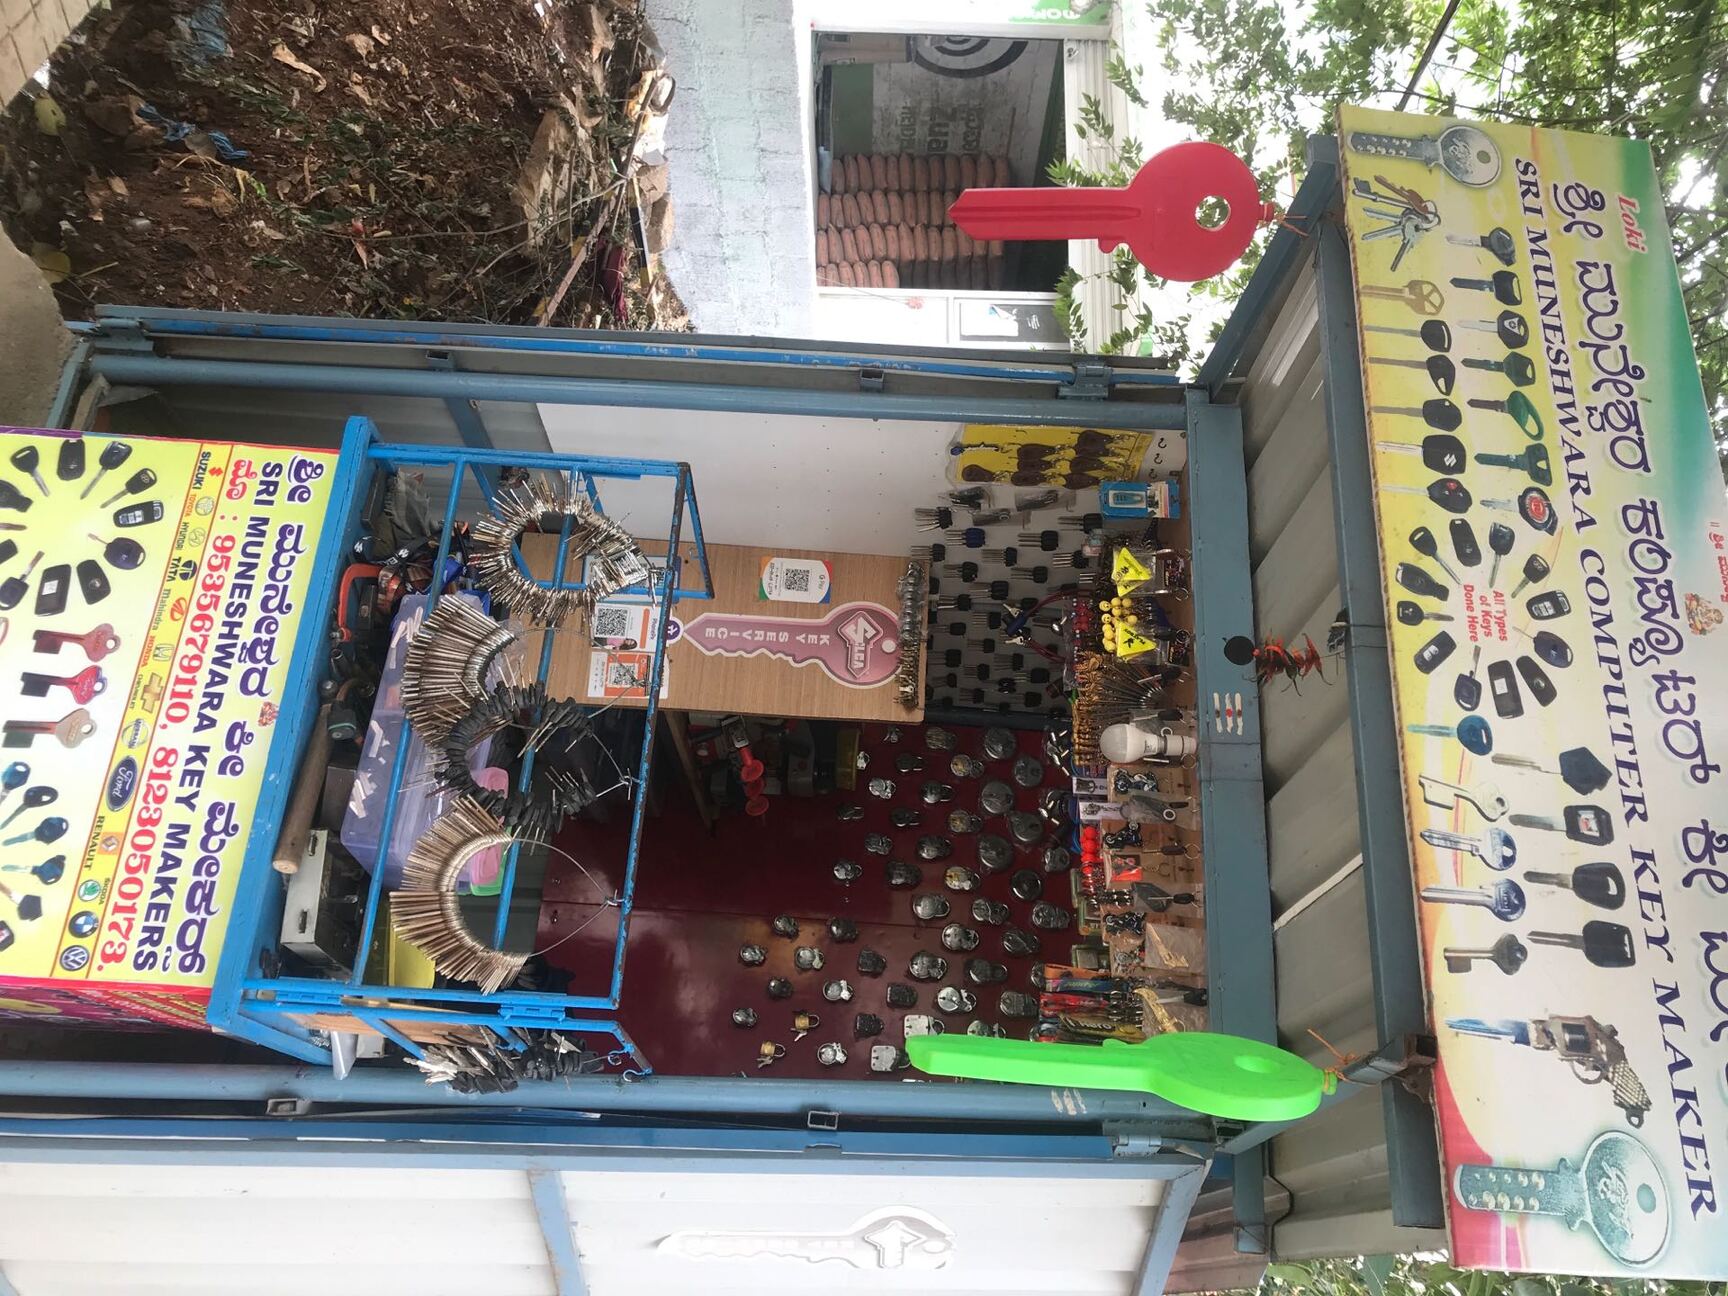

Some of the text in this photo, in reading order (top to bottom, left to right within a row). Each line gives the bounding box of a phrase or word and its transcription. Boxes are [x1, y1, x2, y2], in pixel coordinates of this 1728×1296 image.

[1515, 158, 1544, 219] SRI
[1553, 182, 1606, 239] ಶ್ರೀ
[1617, 196, 1646, 252] Loki
[1526, 226, 1597, 535] MUNESHWARA
[1576, 261, 1651, 473] ಮುನೇಶ್ವರ
[192, 451, 212, 490] SUZUKI
[254, 462, 283, 506] SRI
[288, 457, 324, 503] ಶ್ರೀ
[185, 493, 197, 518] TOYOTA
[176, 522, 190, 550] HYUNDAI
[166, 556, 182, 582] TATA
[159, 534, 237, 729] 9535679110,
[194, 516, 270, 733] MUNESHWARA
[238, 524, 307, 698] ಮುನೇಶ್ವರ
[705, 627, 789, 643] SERVICE
[796, 633, 830, 645] KEY
[1463, 584, 1479, 643] Done Here
[1479, 595, 1493, 638] of Keys
[1493, 590, 1508, 642] All Types
[141, 635, 155, 667] HONDA
[1580, 548, 1649, 828] COMPUTER
[219, 720, 255, 777] ಕೀ
[112, 767, 134, 798] Ford
[175, 745, 211, 813] KEY
[84, 815, 106, 871] RENAULT
[97, 747, 178, 972] 8123050173.
[133, 823, 191, 971] MAKERS
[1630, 844, 1674, 963] KEY
[1652, 977, 1717, 1221] MAKER
